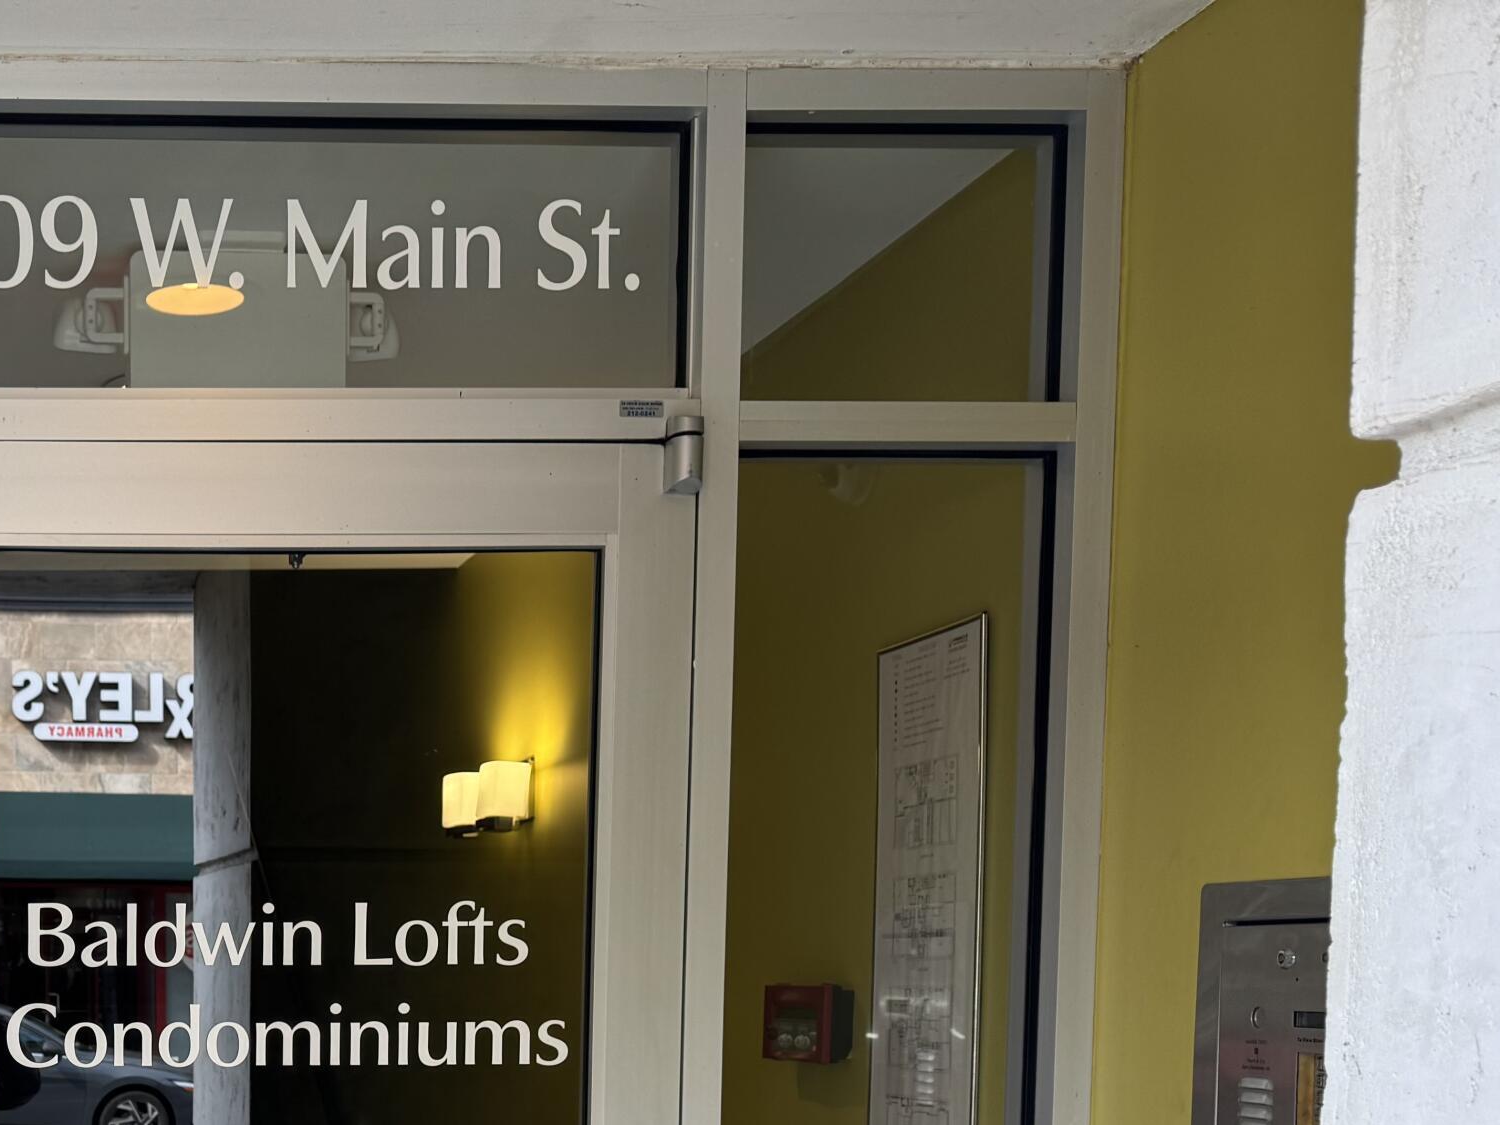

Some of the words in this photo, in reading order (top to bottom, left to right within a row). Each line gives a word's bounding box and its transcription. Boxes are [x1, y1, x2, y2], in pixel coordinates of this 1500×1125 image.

[130, 196, 245, 291] W.
[286, 198, 503, 291] Main
[536, 198, 643, 292] St.
[25, 901, 323, 968] Baldwin
[354, 899, 529, 968] Lofts
[5, 1002, 570, 1069] Condominiums
